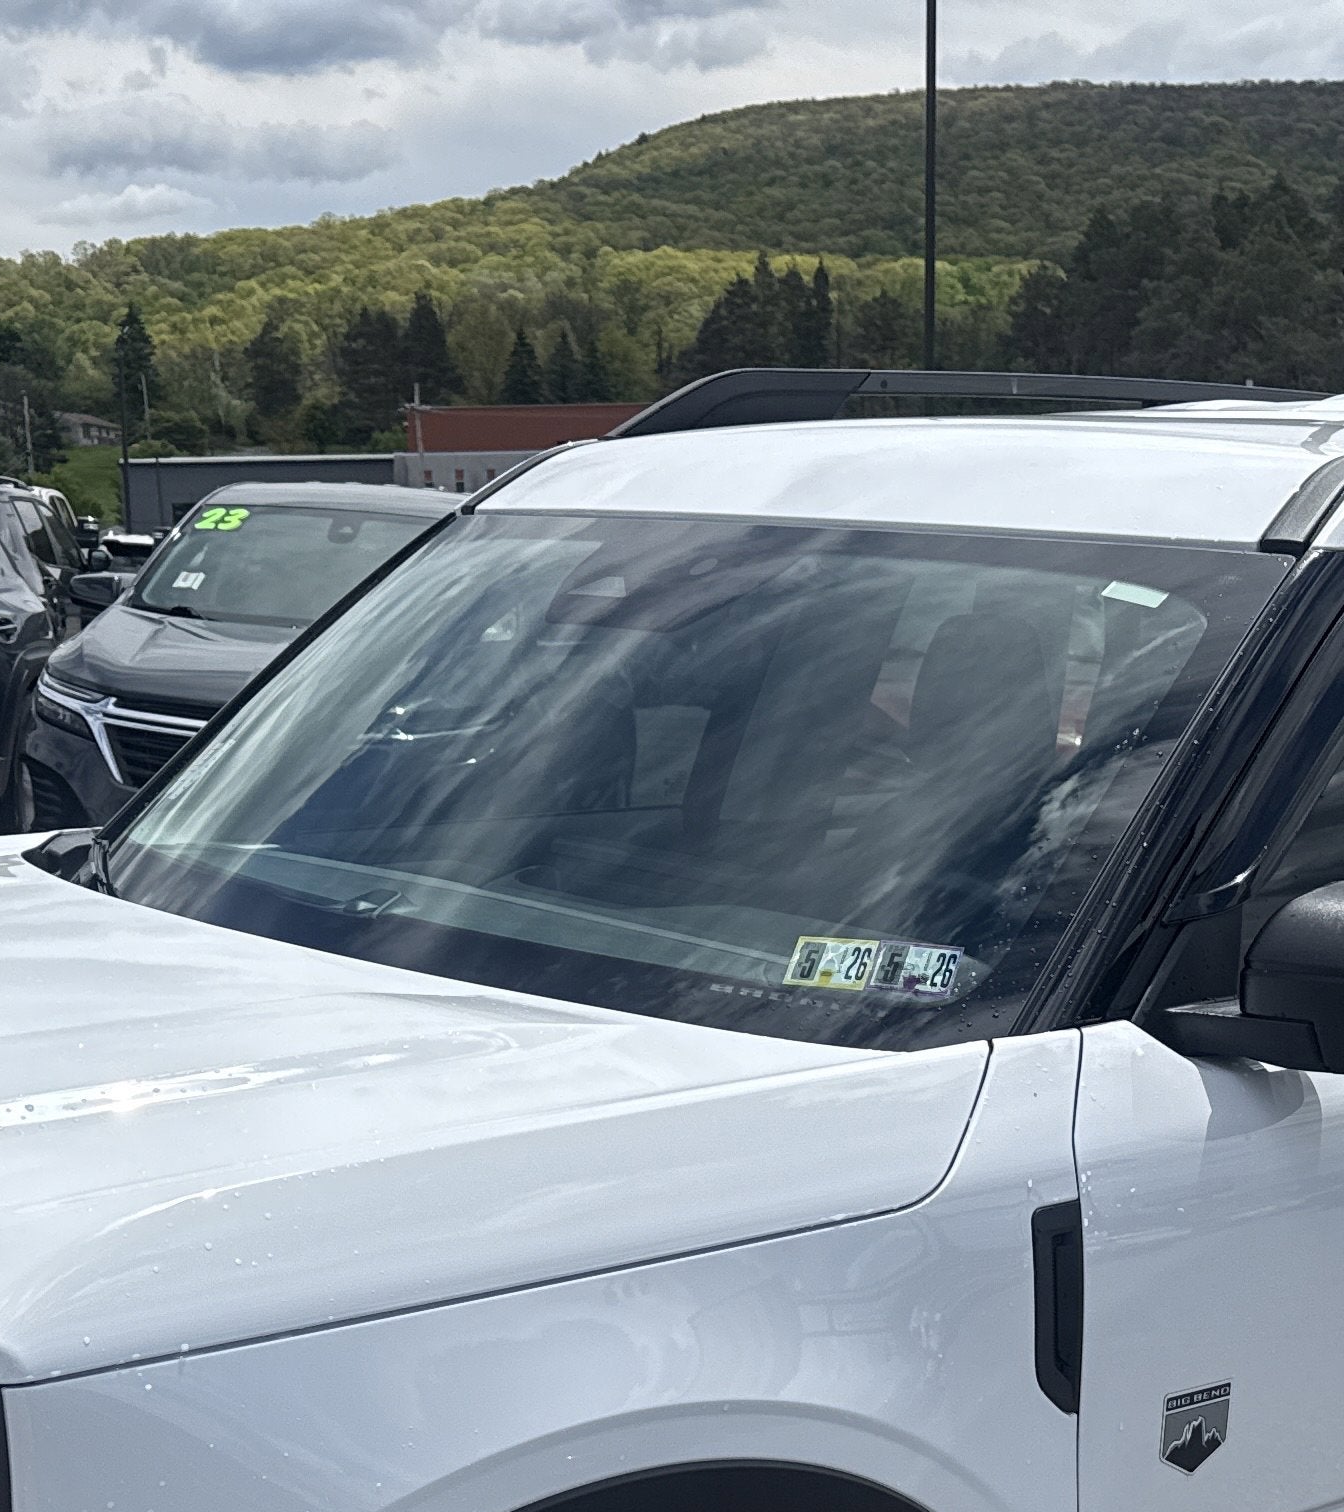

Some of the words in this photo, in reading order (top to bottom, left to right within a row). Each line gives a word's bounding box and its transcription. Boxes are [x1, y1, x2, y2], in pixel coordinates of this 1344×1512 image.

[194, 507, 251, 530] 23
[843, 946, 873, 982] 26
[929, 952, 958, 989] 26
[1167, 1396, 1191, 1409] BIG
[1193, 1386, 1231, 1402] BEND
